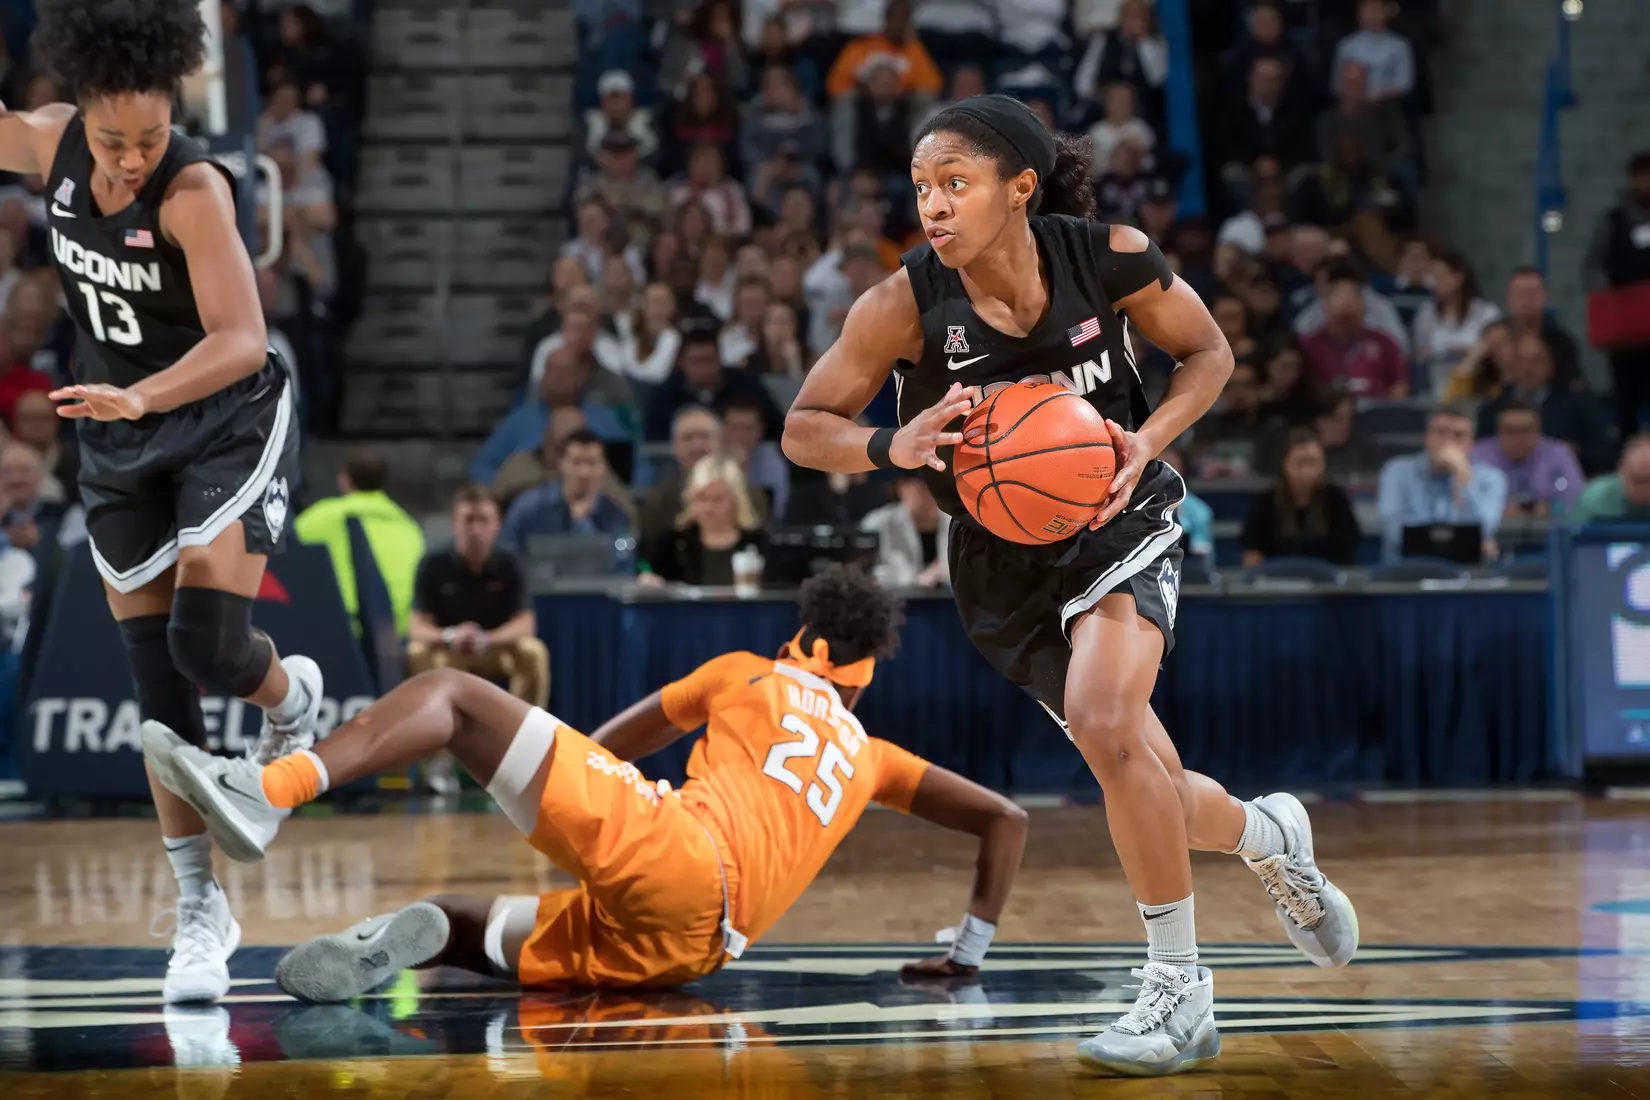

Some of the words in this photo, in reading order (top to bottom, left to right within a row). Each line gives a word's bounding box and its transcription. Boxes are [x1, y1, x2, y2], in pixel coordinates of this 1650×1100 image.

[51, 226, 161, 292] UCONN
[78, 281, 143, 346] 13
[28, 695, 378, 754] TRAELR
[762, 713, 855, 827] 25
